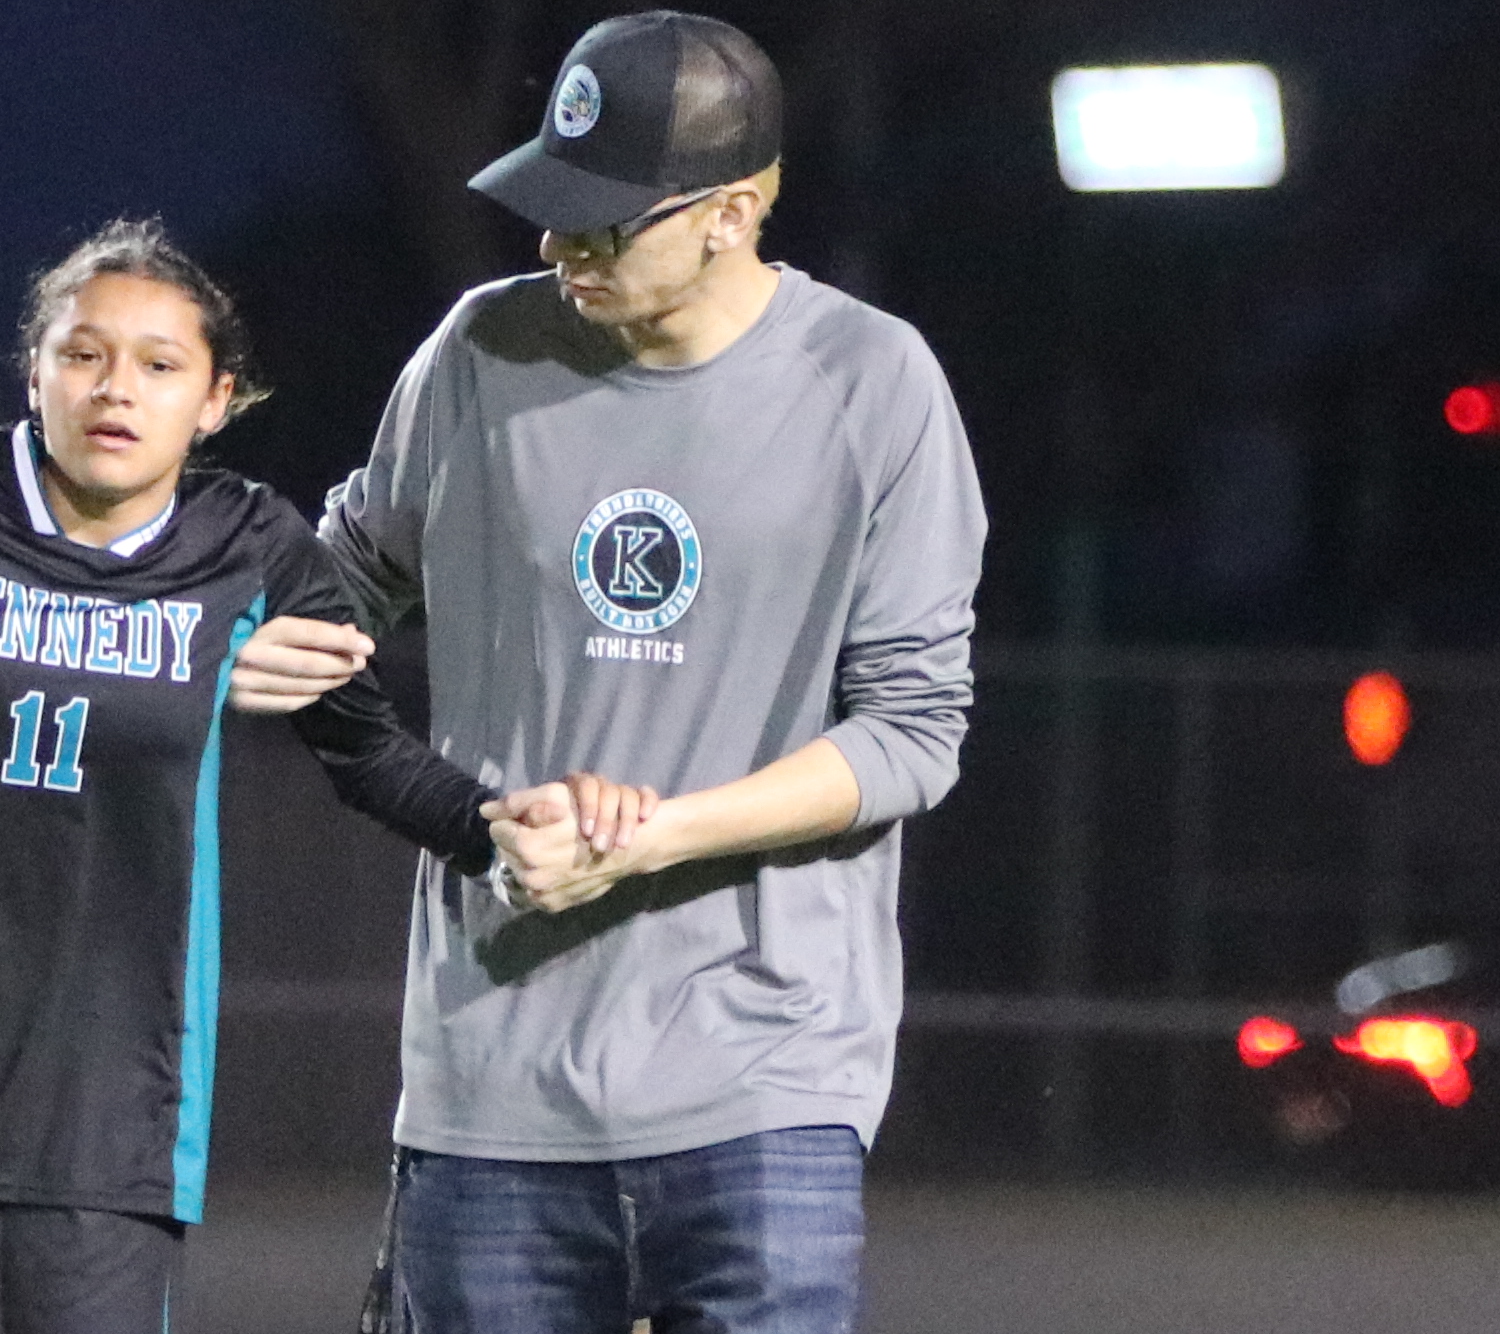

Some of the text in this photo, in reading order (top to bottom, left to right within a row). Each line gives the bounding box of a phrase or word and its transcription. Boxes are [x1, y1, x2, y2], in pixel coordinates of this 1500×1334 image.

[582, 493, 692, 540] THUNDERBIRDS
[608, 525, 663, 597] K
[622, 614, 655, 629] NOT
[585, 636, 684, 664] ATHLETICS
[1, 690, 89, 792] 11
